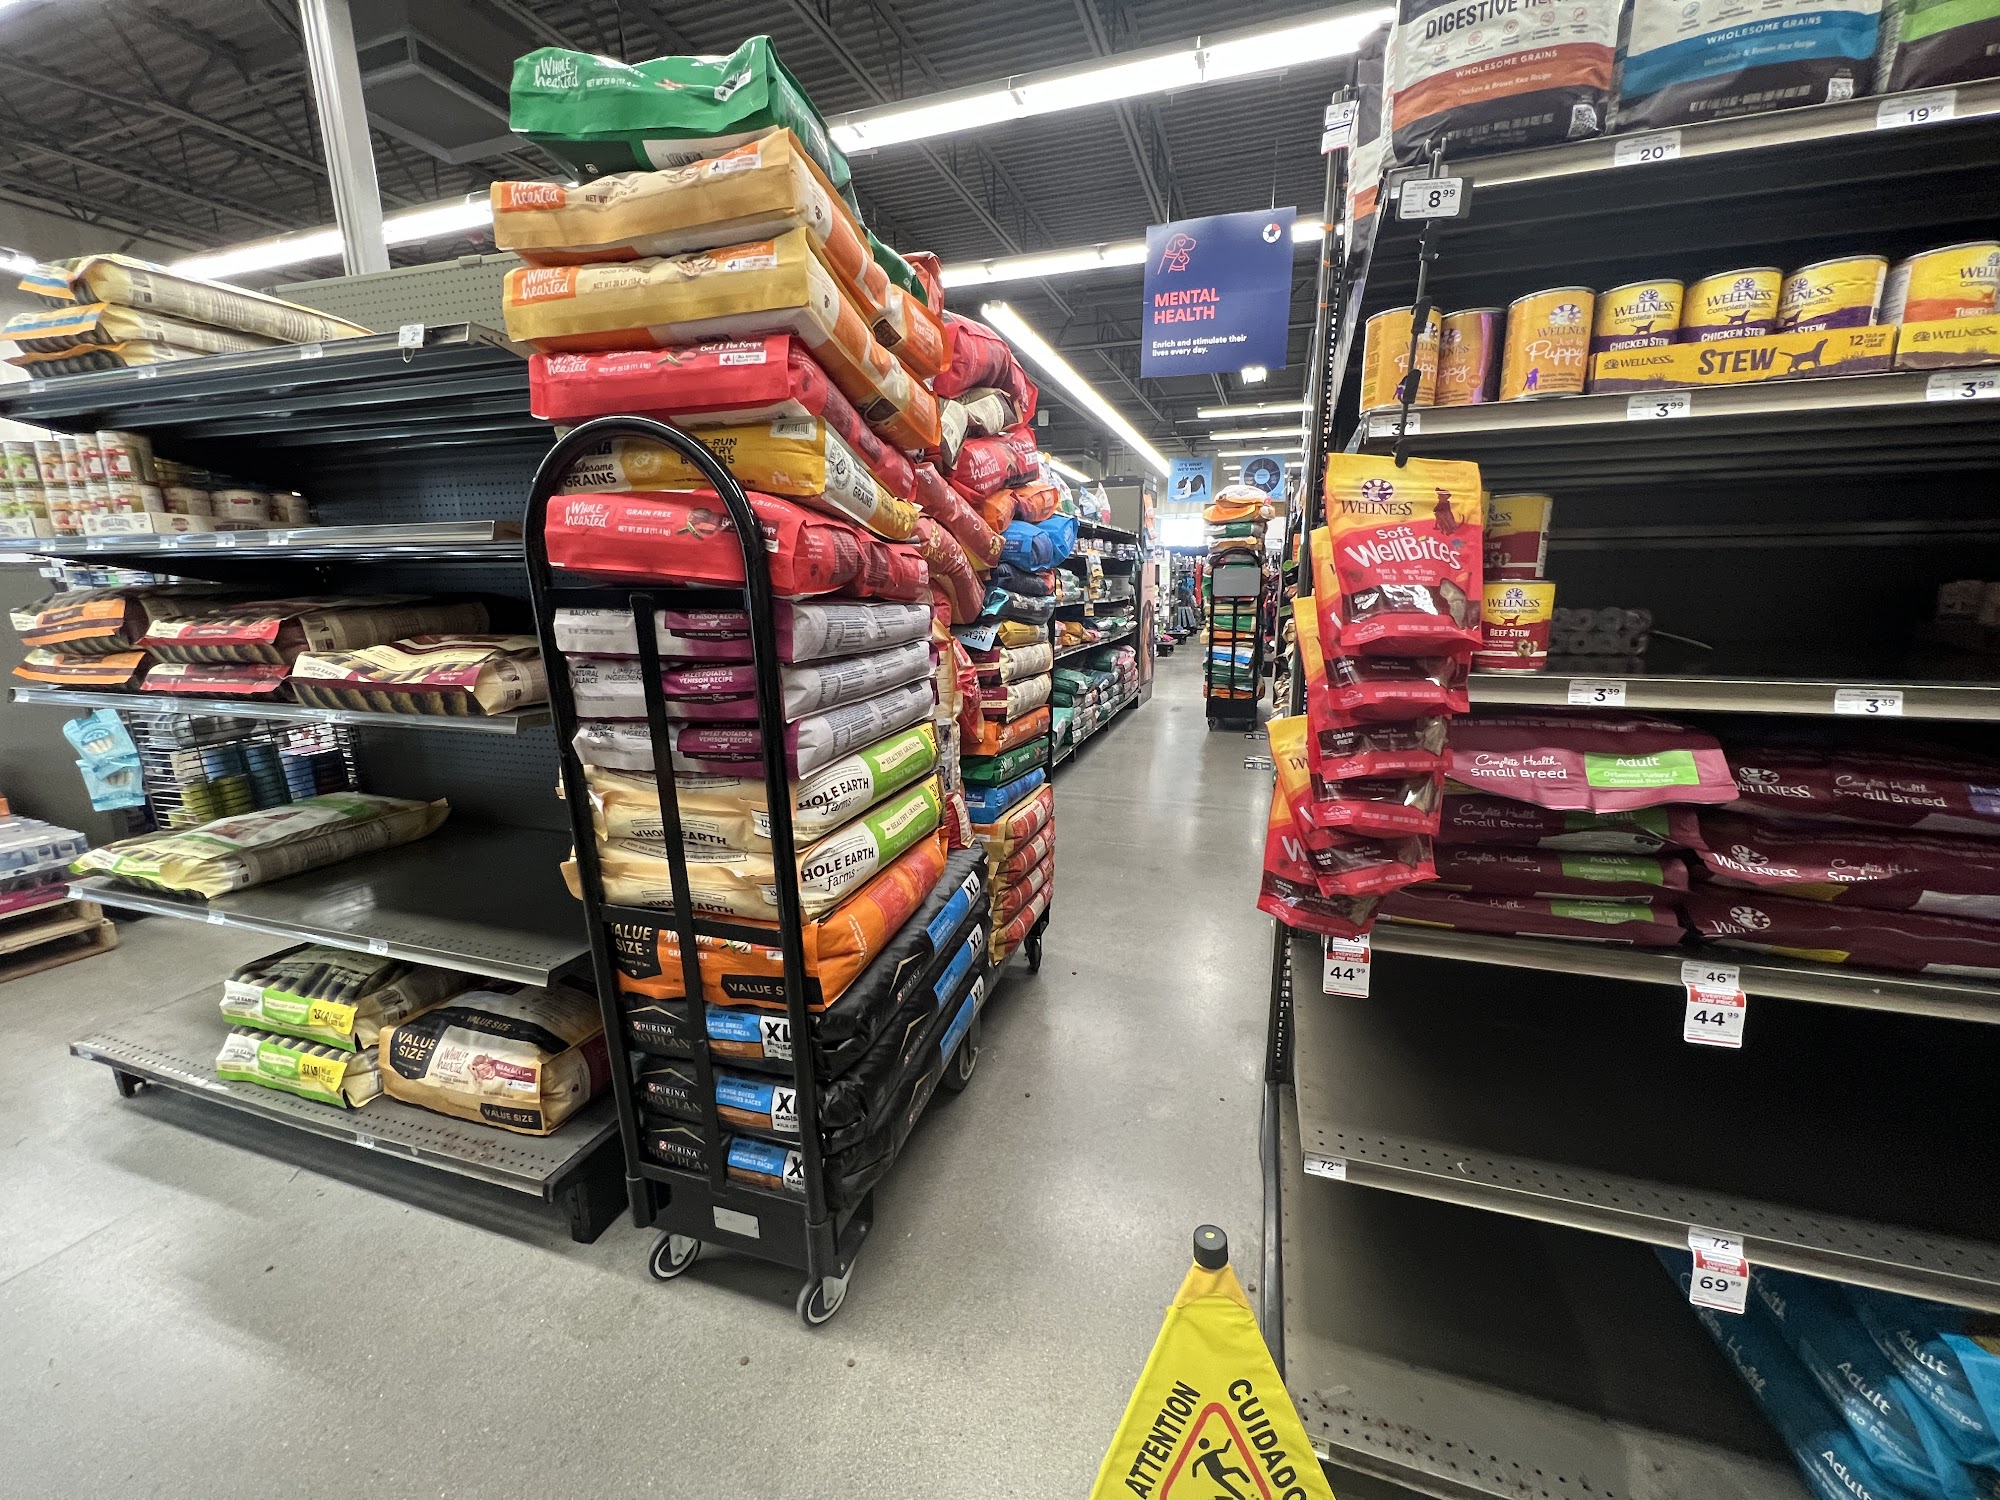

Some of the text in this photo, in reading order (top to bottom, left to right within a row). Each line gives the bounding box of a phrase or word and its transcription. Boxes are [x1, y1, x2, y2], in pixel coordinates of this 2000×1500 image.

[1707, 22, 1779, 45] WHOLESOME
[1783, 15, 1822, 29] GRAINS
[540, 57, 571, 75] WHOLE
[1456, 49, 1558, 79] WHOLESOME GRAINS
[533, 65, 578, 89] hearted
[1457, 84, 1483, 97] Chicken
[1515, 76, 1529, 85] Rice
[1530, 72, 1553, 83] Recipe
[510, 184, 560, 206] hearted
[527, 267, 561, 286] WHOLE
[521, 276, 569, 300] hearted
[1155, 288, 1220, 308] MENTAL
[1707, 290, 1772, 308] WELLNESS
[1154, 305, 1216, 325] HEALTH
[1614, 301, 1674, 318] WELLNESS
[1707, 303, 1747, 315] Complete
[1615, 314, 1651, 325] Complete
[1152, 334, 1247, 349] Enrich and stimulate their
[1701, 327, 1766, 342] CHICKEN STEW
[1850, 335, 1865, 346] 12
[1152, 346, 1208, 357] lives every day.
[1609, 337, 1669, 352] CHICKEN STEW
[1526, 340, 1586, 366] Puppy
[547, 359, 588, 376] hearted
[1621, 355, 1672, 368] WELLNESS
[1698, 347, 1778, 376] STEW
[565, 472, 616, 487] GRAINS
[852, 486, 873, 509] GRAINS
[571, 502, 603, 514] WHOLE
[626, 508, 672, 518] GRAIN FREE
[1341, 501, 1413, 516] WELLNESS
[564, 507, 607, 528] hearted
[1375, 526, 1414, 540] Soft
[1343, 535, 1462, 571] WellBites
[1376, 568, 1391, 576] Moist
[1402, 568, 1436, 576] Whole Fruits
[1415, 574, 1434, 582] Veggies
[1488, 598, 1540, 608] WELLNESS
[1490, 628, 1531, 637] BEEF STEW
[1333, 731, 1354, 740] GRAIN
[1336, 738, 1354, 746] FREE
[886, 742, 917, 764] HEALTHY GRAINS
[1475, 755, 1561, 767] Complete Health
[1616, 757, 1660, 767] Adult
[1471, 768, 1567, 779] Small Breed
[1642, 771, 1670, 779] Turkey
[841, 778, 869, 797] EARTH
[1836, 775, 1886, 790] Complete
[1833, 788, 1948, 808] Small Breed
[822, 797, 851, 815] farms
[1460, 804, 1501, 818] Complete
[890, 802, 921, 830] HEALTHY GRAINS
[1453, 818, 1544, 830] Small Breed
[682, 831, 727, 845] EARTH
[846, 847, 874, 866] EARTH
[1455, 851, 1497, 864] Complete
[1590, 856, 1630, 865] Adult
[825, 869, 856, 891] farms
[964, 876, 979, 899] XL
[971, 930, 983, 952] XL
[616, 942, 644, 956] SIZE
[728, 983, 772, 994] VALUE
[1701, 993, 1735, 1001] EVERYDAY
[467, 1015, 511, 1032] VALUE SIZE
[641, 1023, 672, 1034] PURINA
[707, 1026, 731, 1035] GRANDES
[398, 1032, 437, 1051] VALUE
[398, 1046, 426, 1061] SIZE
[656, 1087, 686, 1098] PURINA
[719, 1093, 762, 1107] GRANDES RACES
[484, 1109, 534, 1123] VALUE SIZE
[667, 1144, 698, 1158] PURINA
[732, 1155, 774, 1170] GRANDES RACES
[1898, 1329, 1948, 1376] Adult
[1837, 1362, 1891, 1415] Adult
[1929, 1393, 1984, 1432] Recipe
[1124, 1380, 1201, 1500] ATTENTION
[1822, 1450, 1874, 1500] Adult
